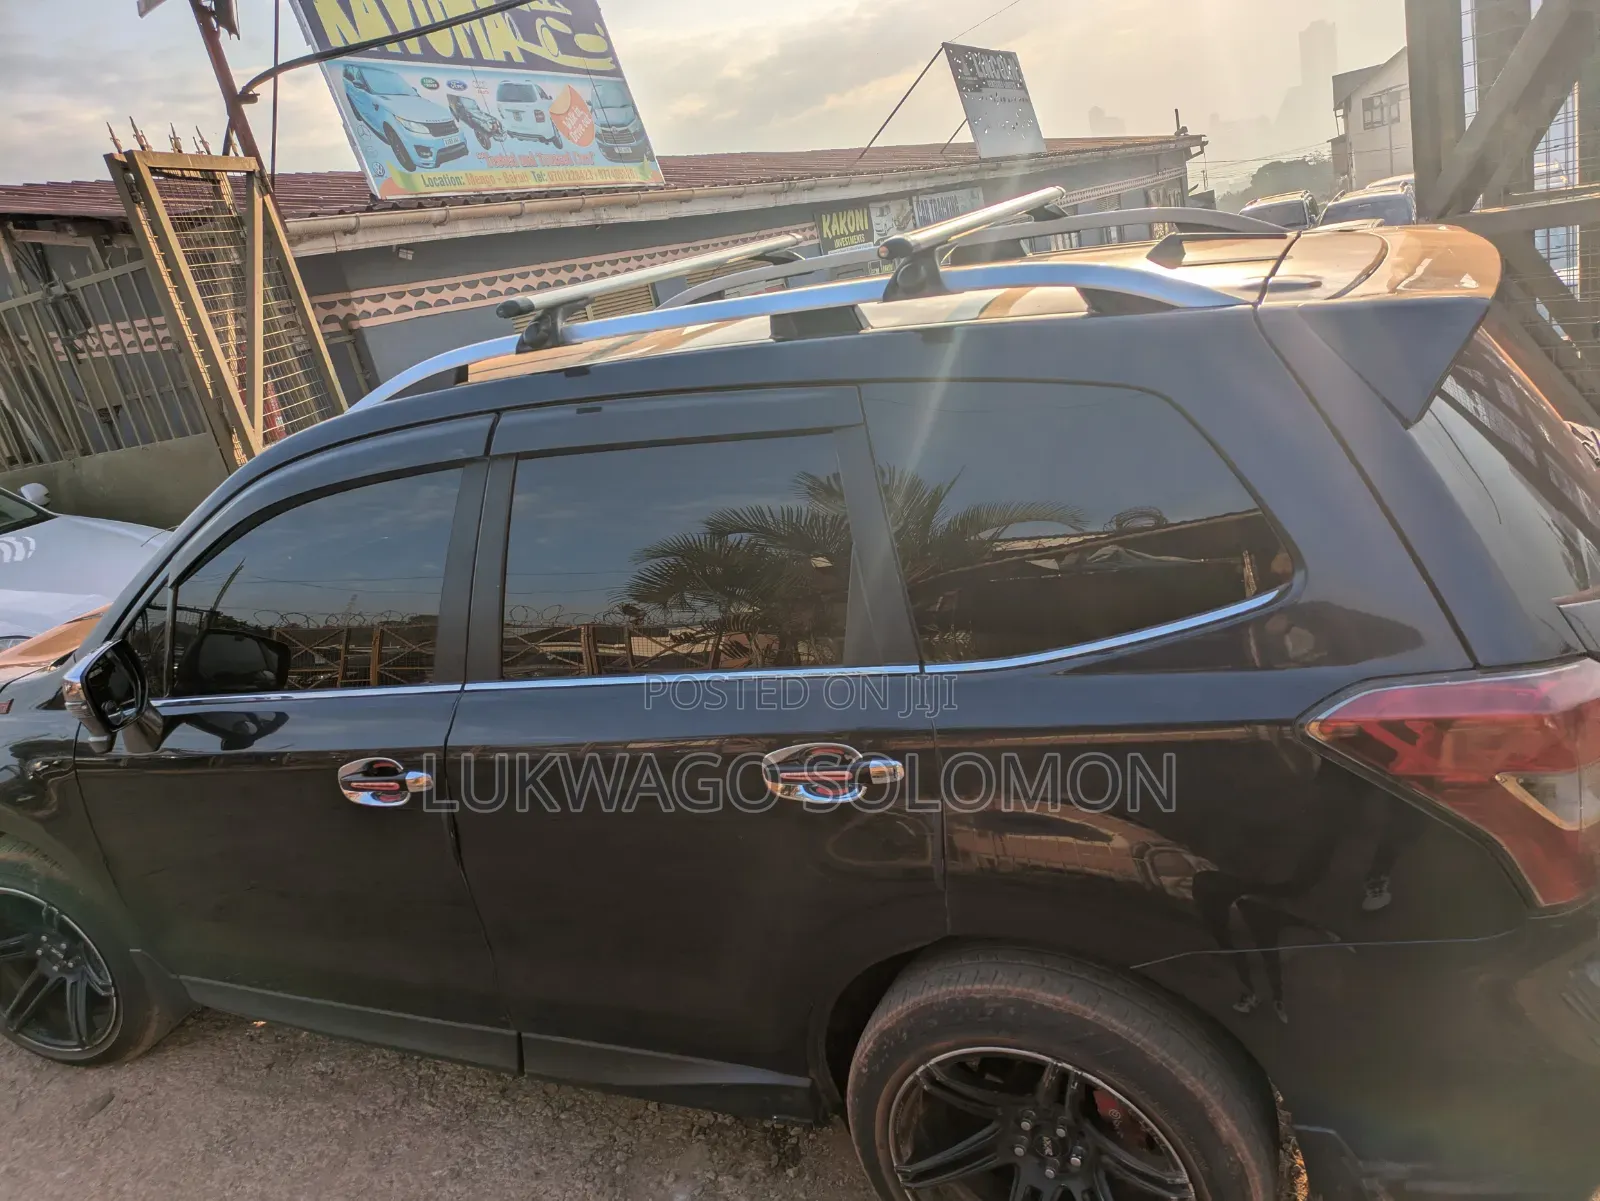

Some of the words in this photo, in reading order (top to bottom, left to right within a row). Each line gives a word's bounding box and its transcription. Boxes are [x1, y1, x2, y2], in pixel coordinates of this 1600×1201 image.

[421, 173, 465, 187] Location:
[531, 171, 547, 182] Tel:
[821, 208, 869, 239] KAKONI
[834, 233, 865, 248] INVESTMENTS
